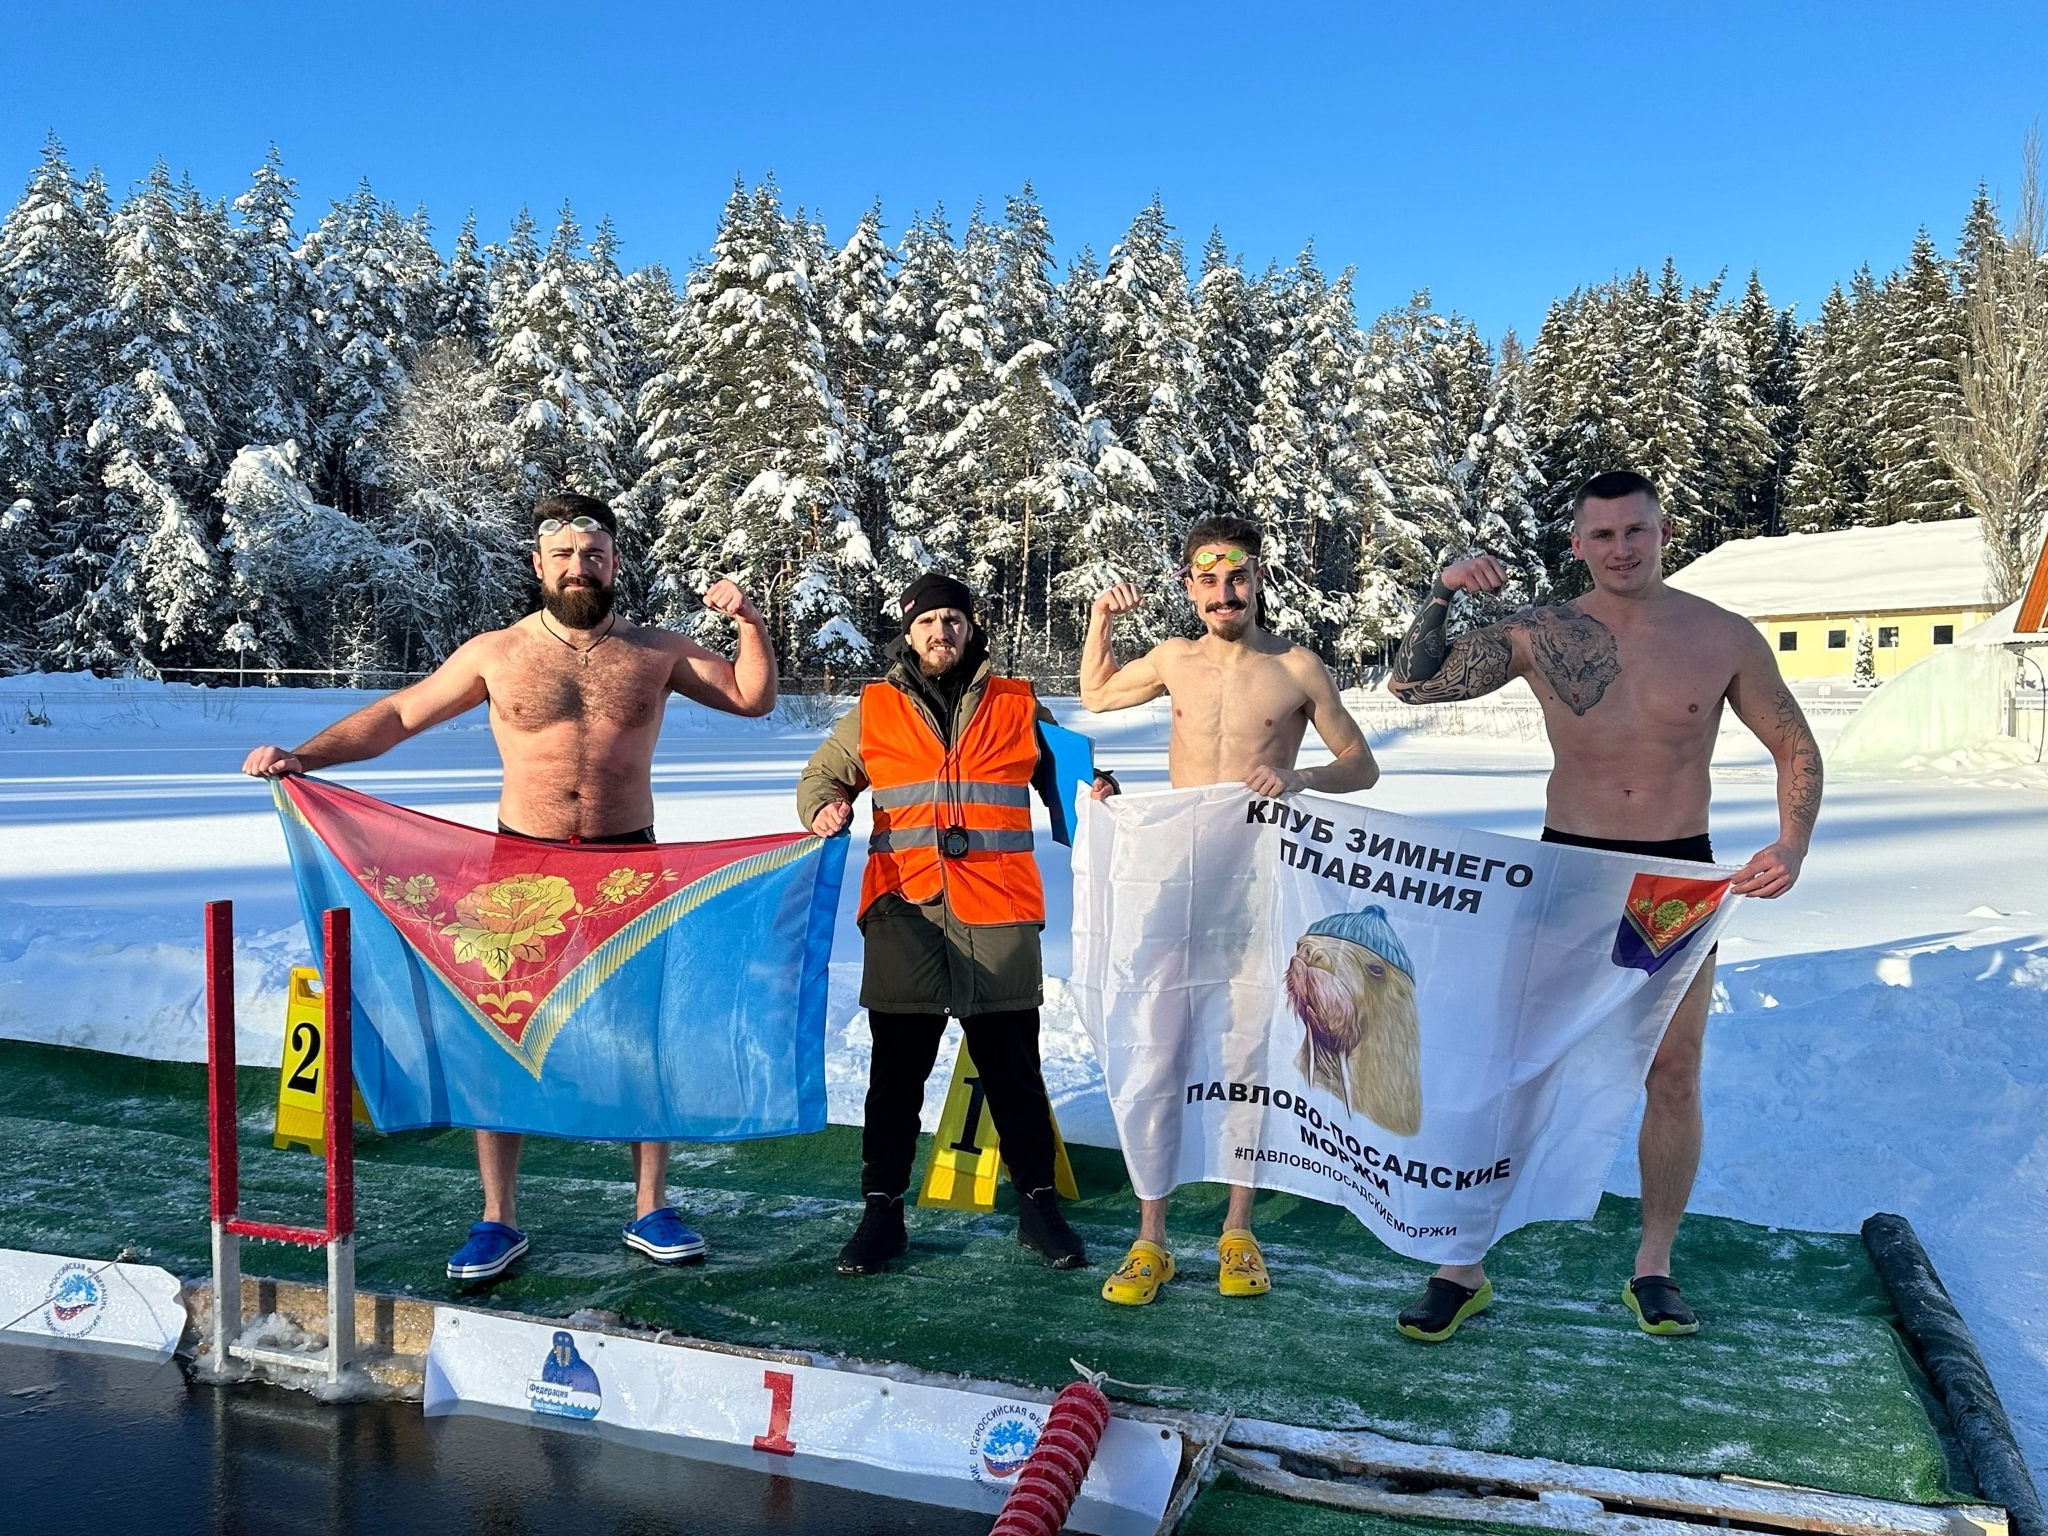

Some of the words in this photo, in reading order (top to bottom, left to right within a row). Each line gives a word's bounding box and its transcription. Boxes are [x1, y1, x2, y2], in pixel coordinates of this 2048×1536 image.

[1246, 799, 1336, 845] КЛУБ
[1345, 827, 1534, 888] ЗИМНЕГО
[1280, 837, 1483, 915] ПЛАВАНИЯ
[287, 1022, 321, 1095] 2
[950, 1076, 985, 1156] 1
[1186, 1081, 1511, 1192] ПАВЛОВО-ПОСАДСКИЕ
[1234, 1146, 1458, 1239] #ПАВЛОВОПОСАДСКИЕМОРЖИ
[1300, 1124, 1391, 1197] МОРЖИ
[528, 1383, 569, 1399] Федерация
[753, 1369, 797, 1458] 1
[969, 1404, 1028, 1456] ВСЕРОССИЙСКАЯ
